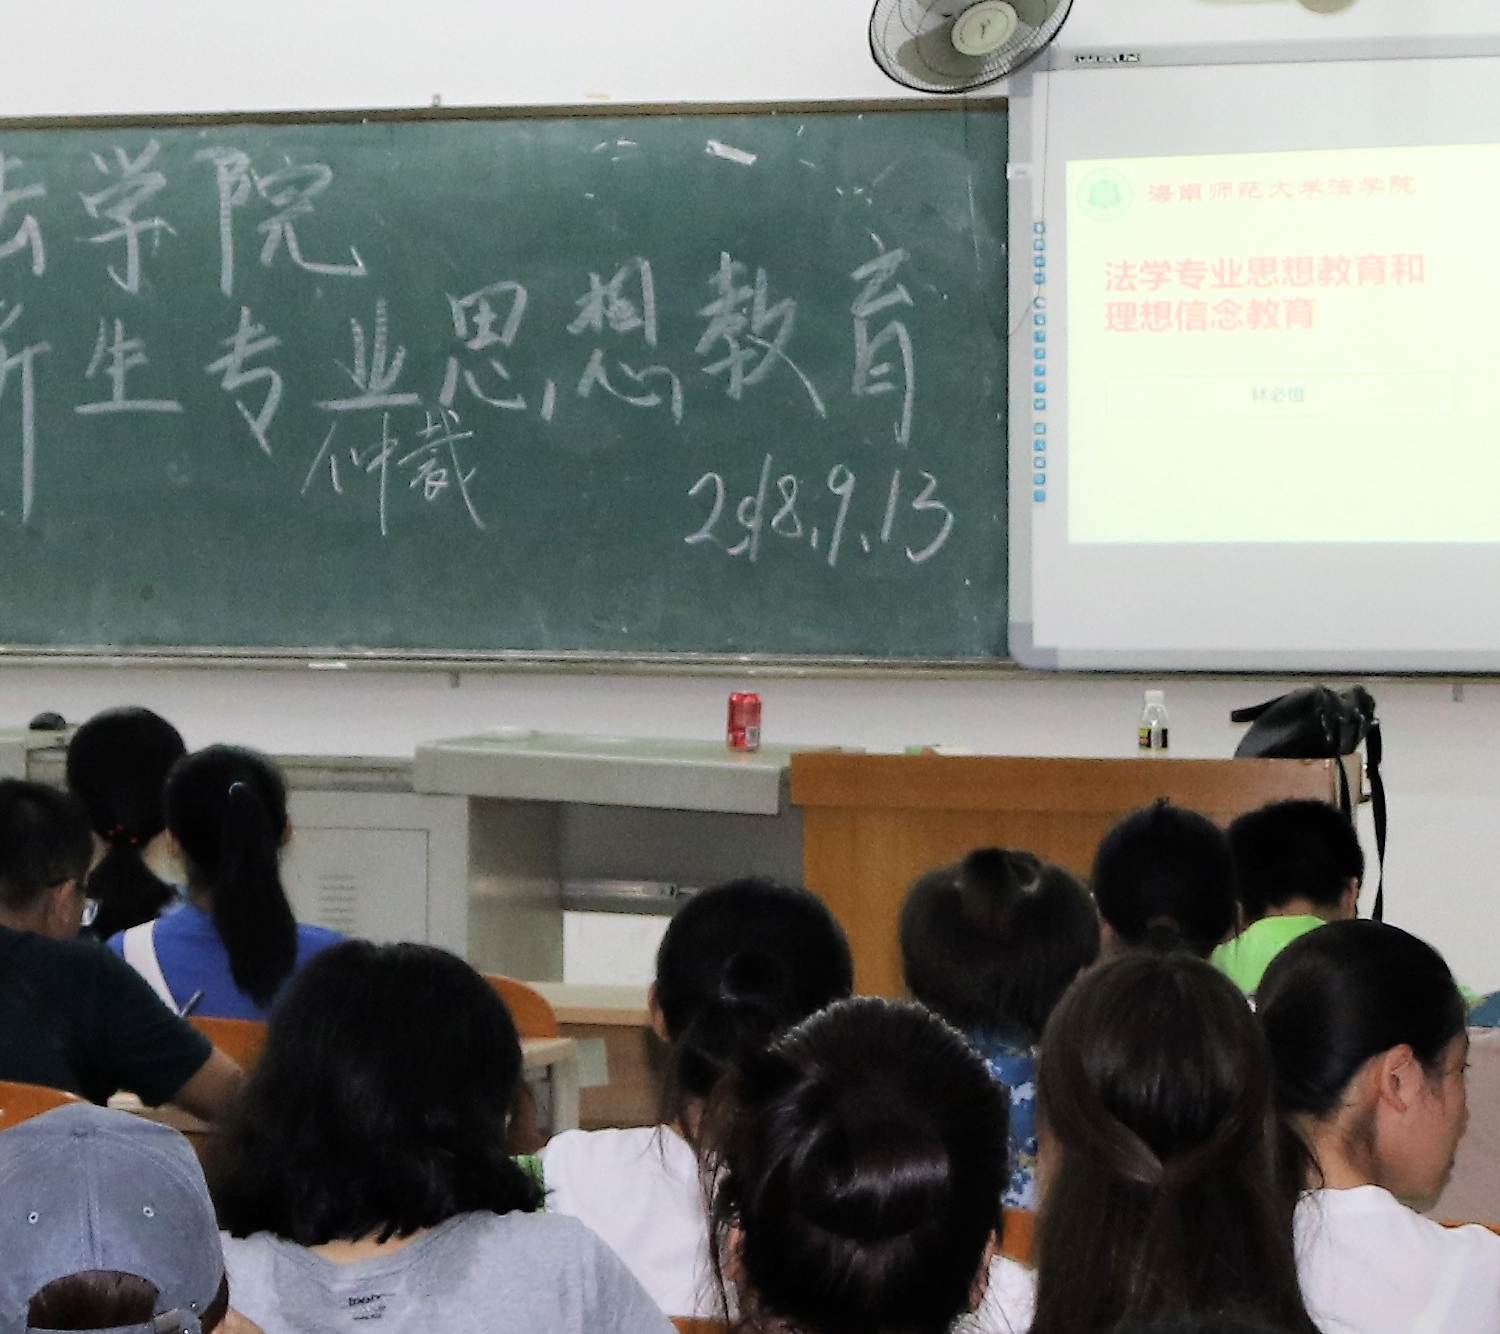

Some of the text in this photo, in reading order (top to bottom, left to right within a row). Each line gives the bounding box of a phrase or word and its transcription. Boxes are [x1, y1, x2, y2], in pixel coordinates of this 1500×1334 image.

[1147, 174, 1417, 203] 海南师范大学法学院
[1103, 253, 1425, 293] 法学专业思想教育和
[1103, 296, 1317, 333] 理想信念教育
